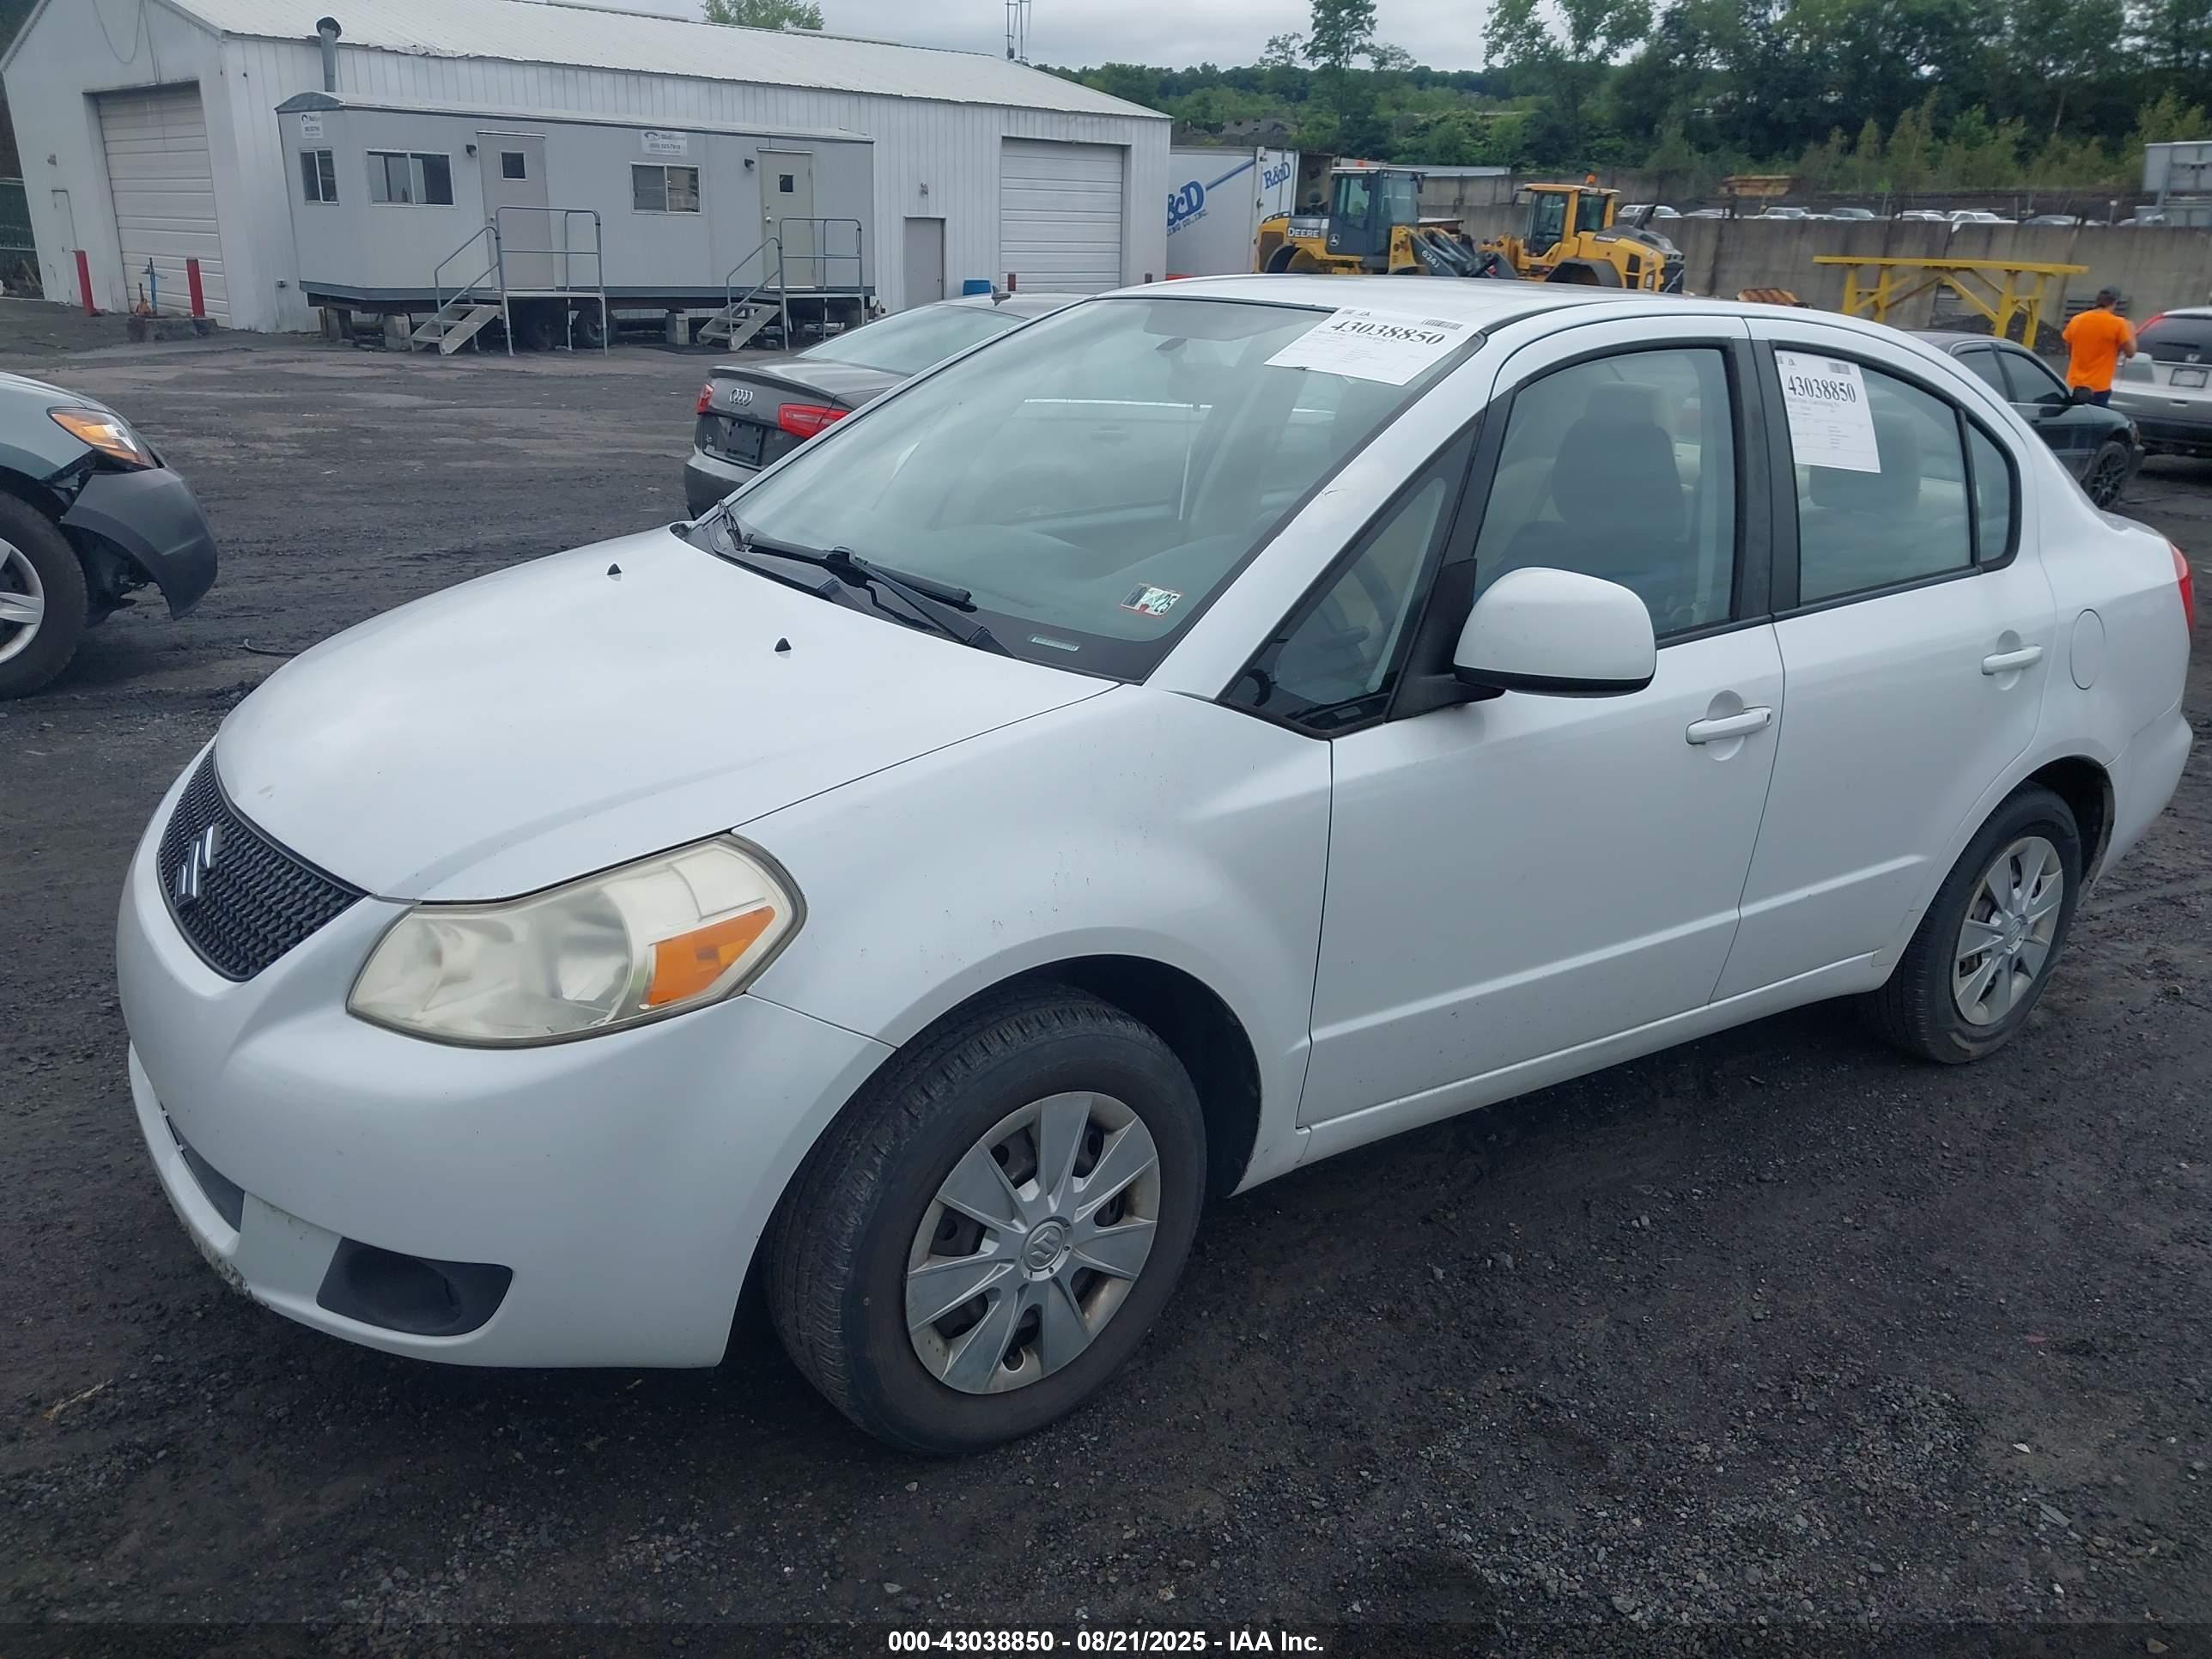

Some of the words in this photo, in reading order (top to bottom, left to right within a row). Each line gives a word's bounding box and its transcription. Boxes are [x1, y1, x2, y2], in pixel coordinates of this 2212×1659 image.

[1263, 161, 1291, 190] R&D
[1288, 228, 1320, 238] DEERE
[1330, 319, 1446, 345] 43038850
[1788, 375, 1856, 403] 43038850
